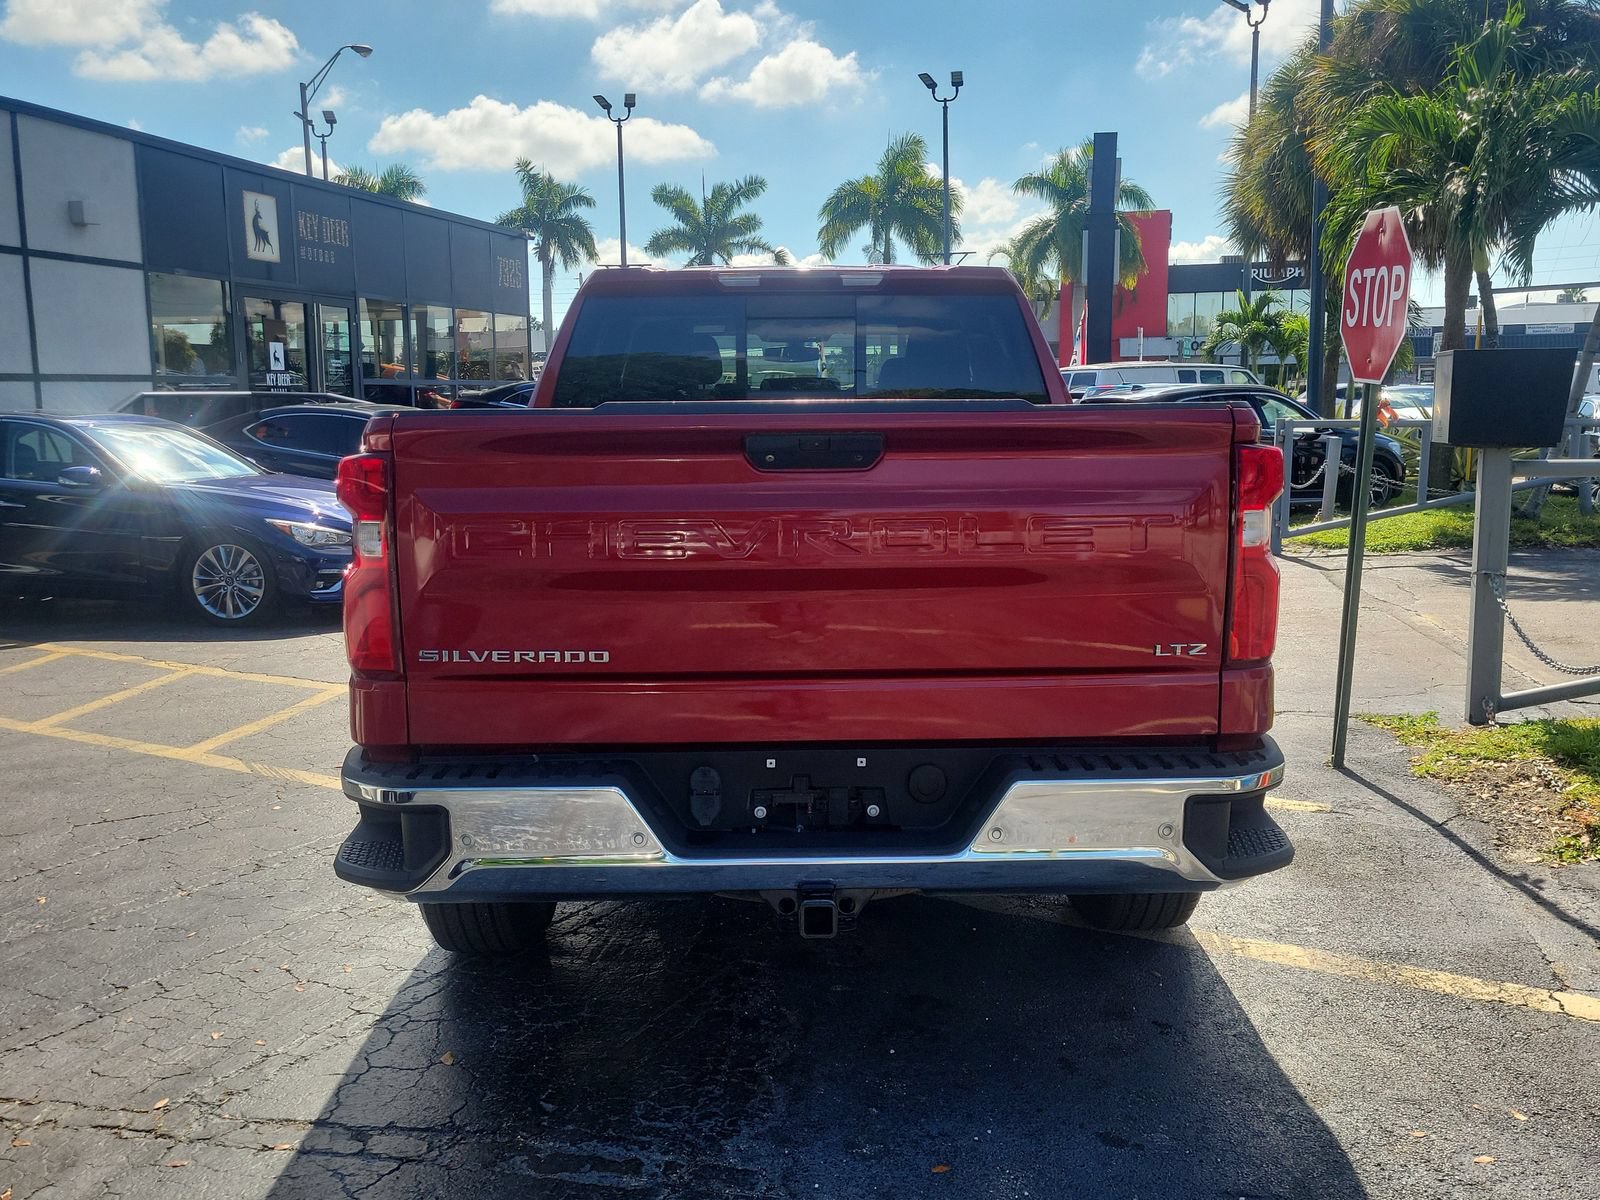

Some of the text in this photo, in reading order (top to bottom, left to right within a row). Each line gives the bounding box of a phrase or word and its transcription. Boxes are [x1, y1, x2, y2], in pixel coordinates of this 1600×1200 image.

[298, 210, 349, 247] KEY DEER
[300, 246, 335, 264] MOTORS
[1241, 267, 1305, 282] RIUMPH
[1346, 265, 1405, 328] STOP
[266, 373, 291, 386] KEY DEER
[452, 514, 1175, 560] CHEVROLET
[418, 649, 610, 664] SILVERADO
[1153, 643, 1208, 657] LTZ
